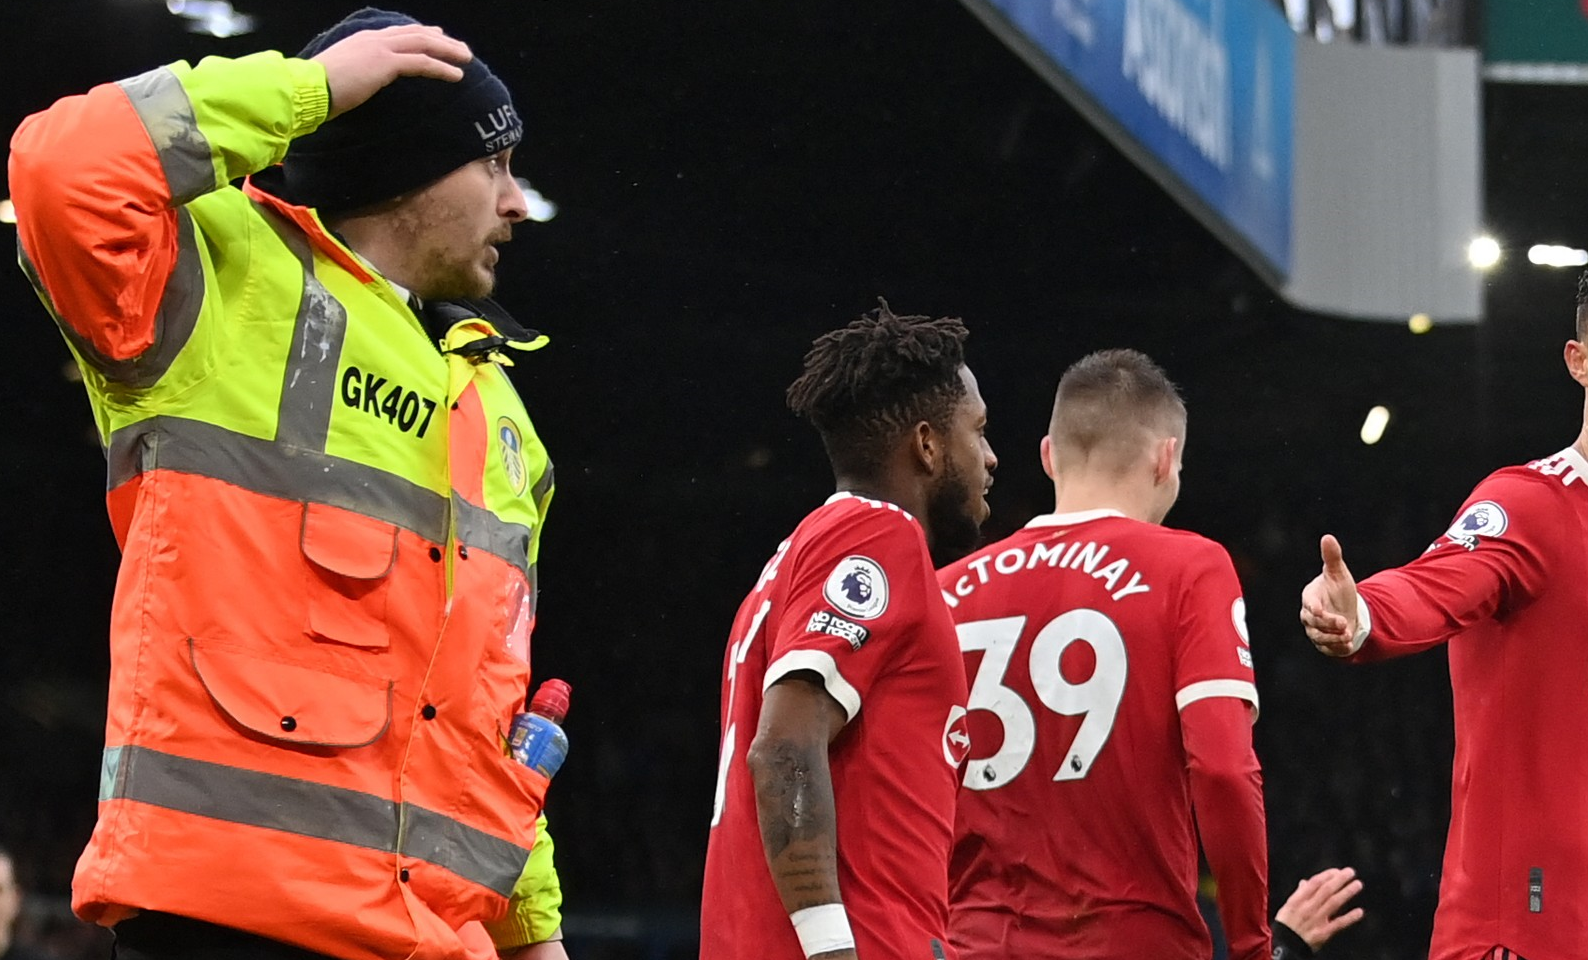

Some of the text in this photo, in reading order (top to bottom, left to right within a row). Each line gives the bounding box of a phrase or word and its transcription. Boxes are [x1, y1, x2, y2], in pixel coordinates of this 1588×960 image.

[474, 104, 515, 140] LUF
[341, 366, 437, 439] GK407
[829, 616, 867, 641] room
[955, 608, 1128, 791] 39
